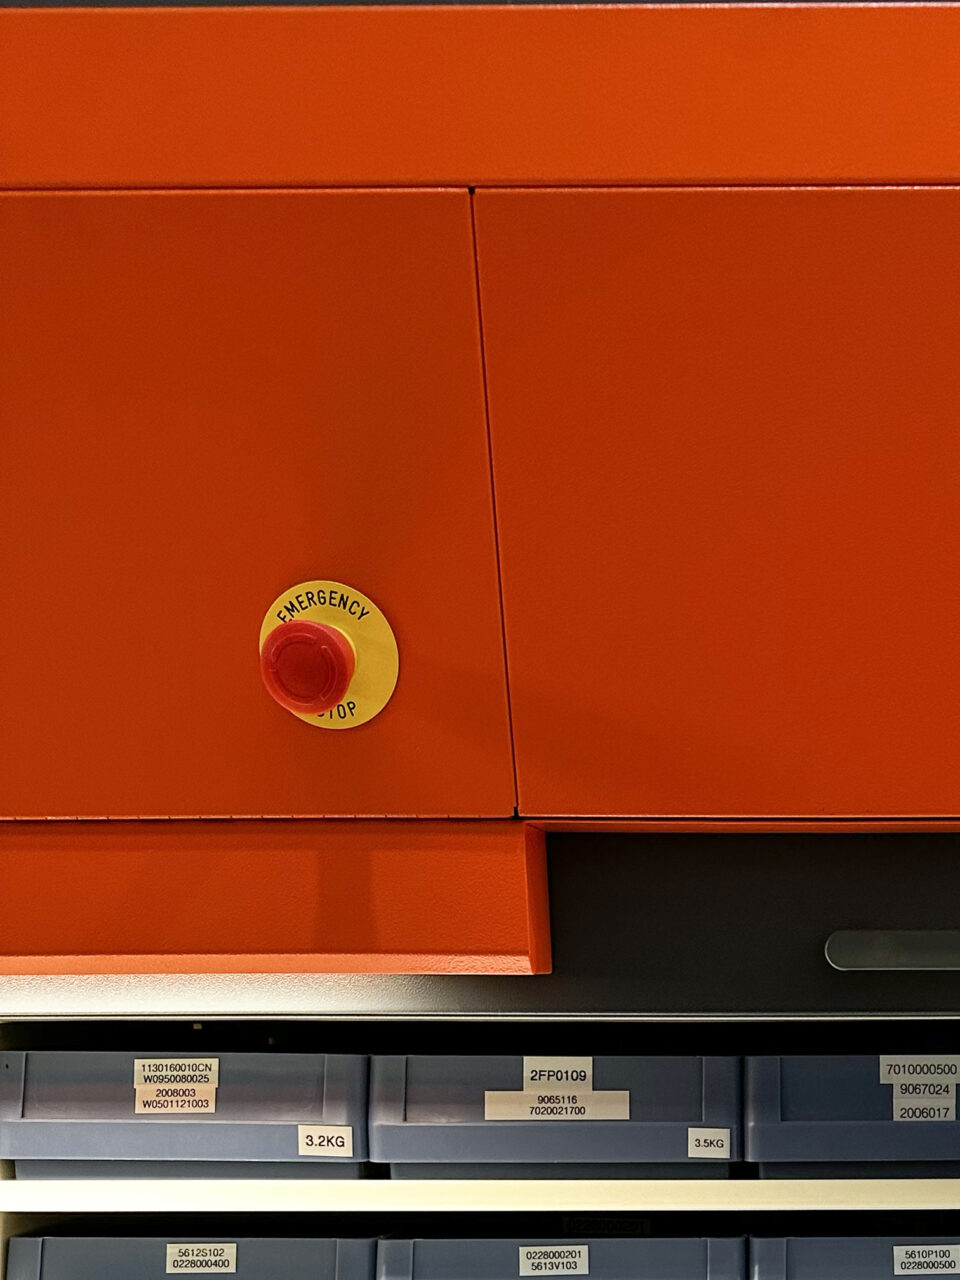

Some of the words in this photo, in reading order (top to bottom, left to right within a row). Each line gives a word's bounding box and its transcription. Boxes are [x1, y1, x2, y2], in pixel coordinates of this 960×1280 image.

[277, 590, 369, 623] EMERGENCY
[141, 1062, 213, 1073] 1130160010CN
[886, 1063, 958, 1076] 7010000500
[143, 1073, 210, 1084] W0950080025
[529, 1069, 587, 1082] 2FP0109
[155, 1088, 197, 1098] 2008003
[899, 1083, 950, 1096] 9067024
[142, 1098, 210, 1109] W0501121003
[537, 1094, 578, 1105] 9065116
[529, 1105, 586, 1116] 7020021700
[899, 1106, 950, 1119] 2006017
[305, 1134, 345, 1148] 3.2KG
[694, 1138, 725, 1149] 3.5KG
[177, 1247, 225, 1258] 5612S102
[525, 1249, 582, 1261] 0228000201
[904, 1249, 951, 1260] 5610P100
[172, 1258, 230, 1269] 0228000400
[531, 1260, 578, 1271] 5613V103
[900, 1259, 957, 1271] 0228000500
